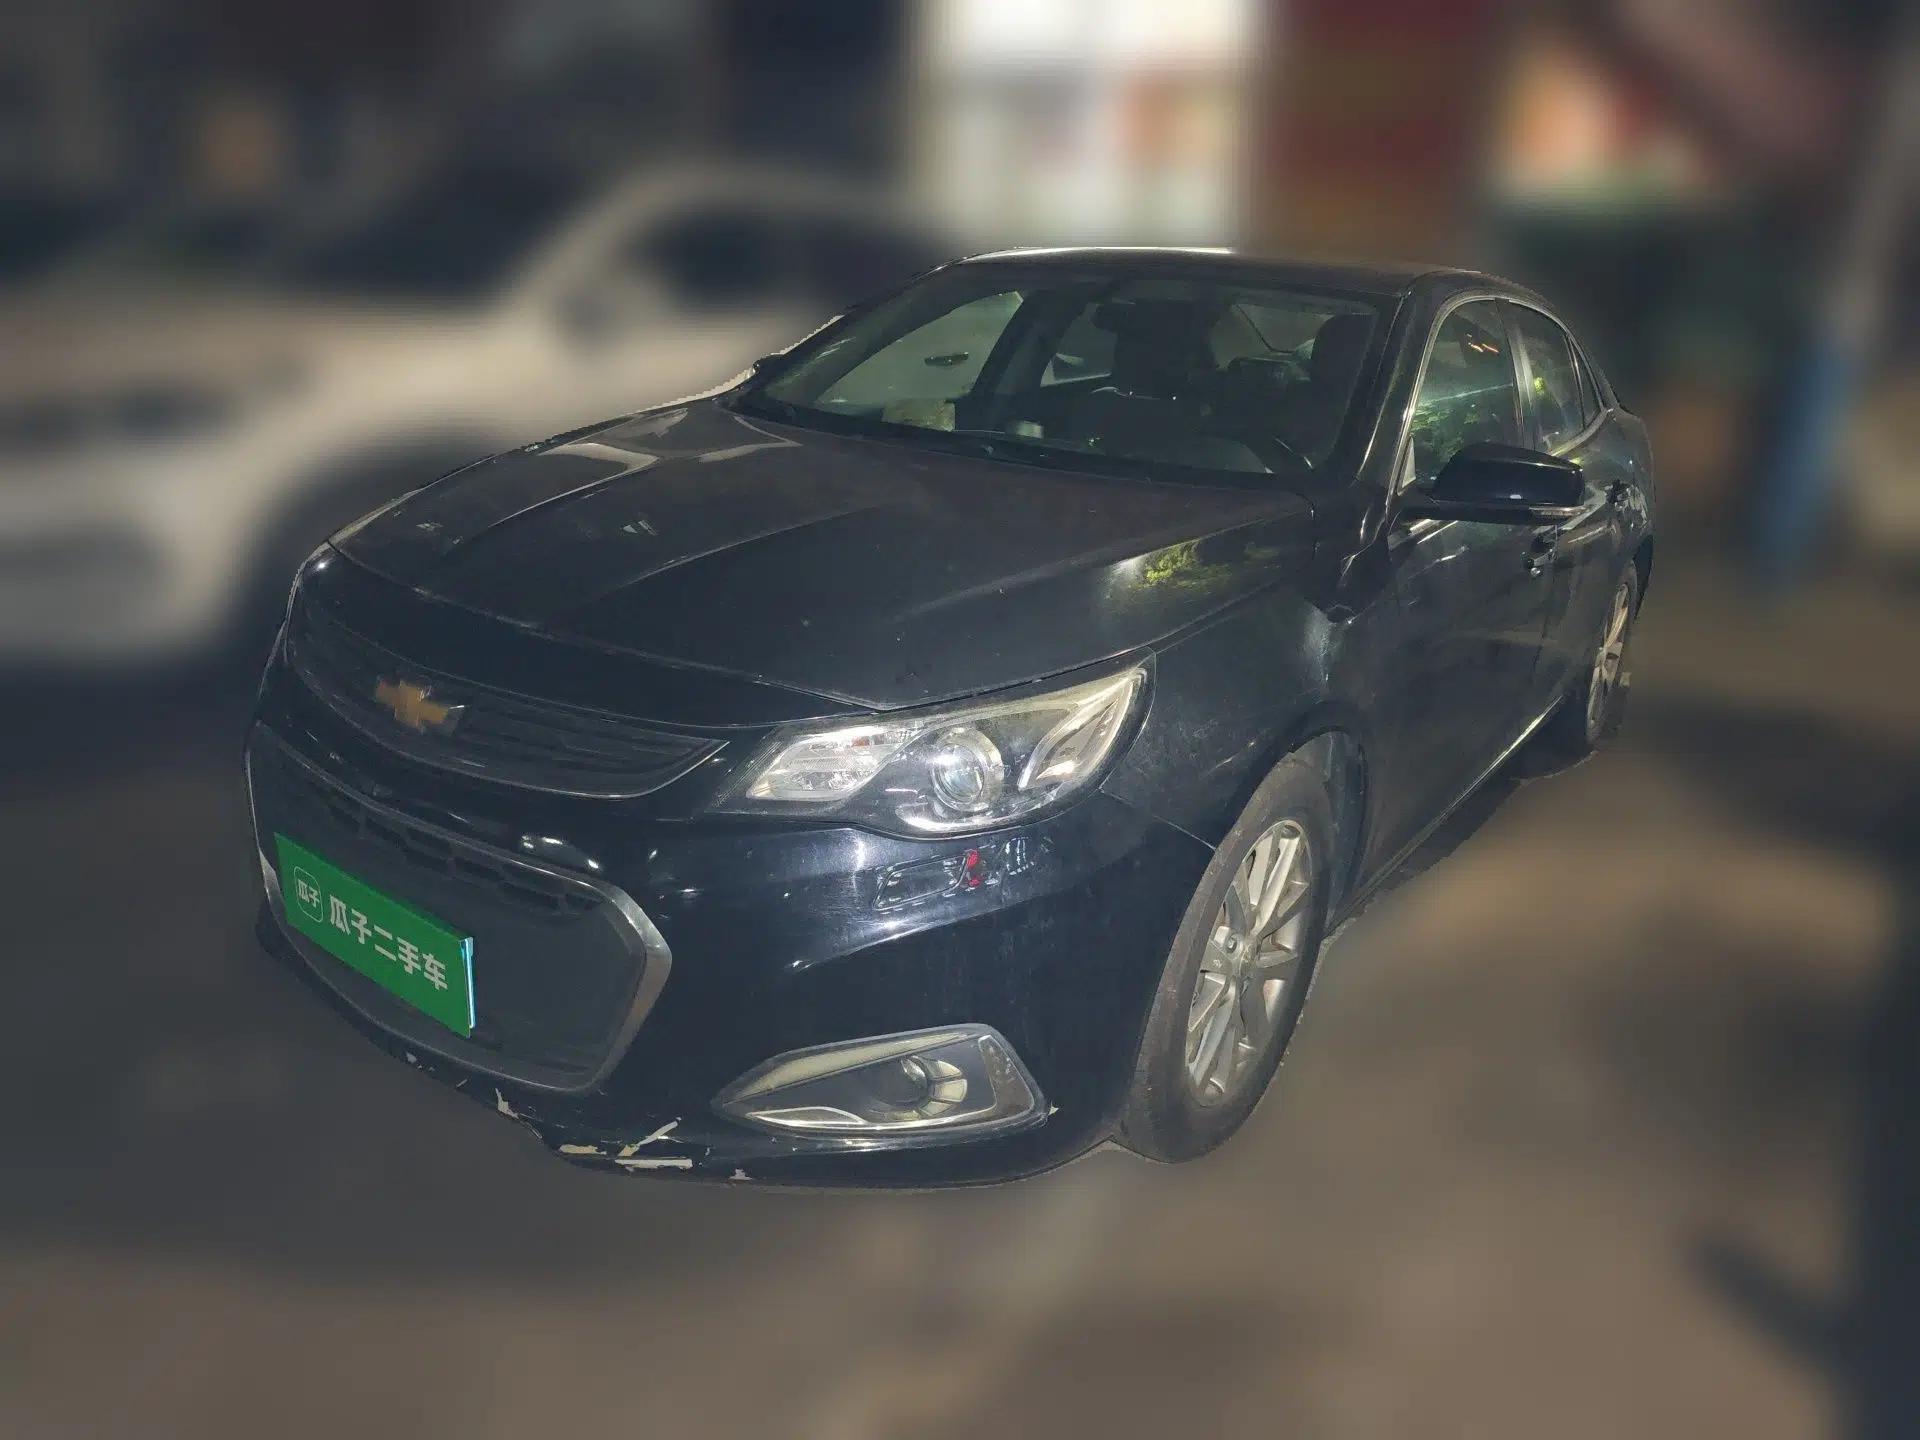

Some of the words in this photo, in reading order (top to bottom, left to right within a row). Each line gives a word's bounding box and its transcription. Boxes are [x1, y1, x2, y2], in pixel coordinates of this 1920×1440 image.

[298, 879, 320, 908] 瓜子
[329, 894, 448, 990] 瓜子二手车
